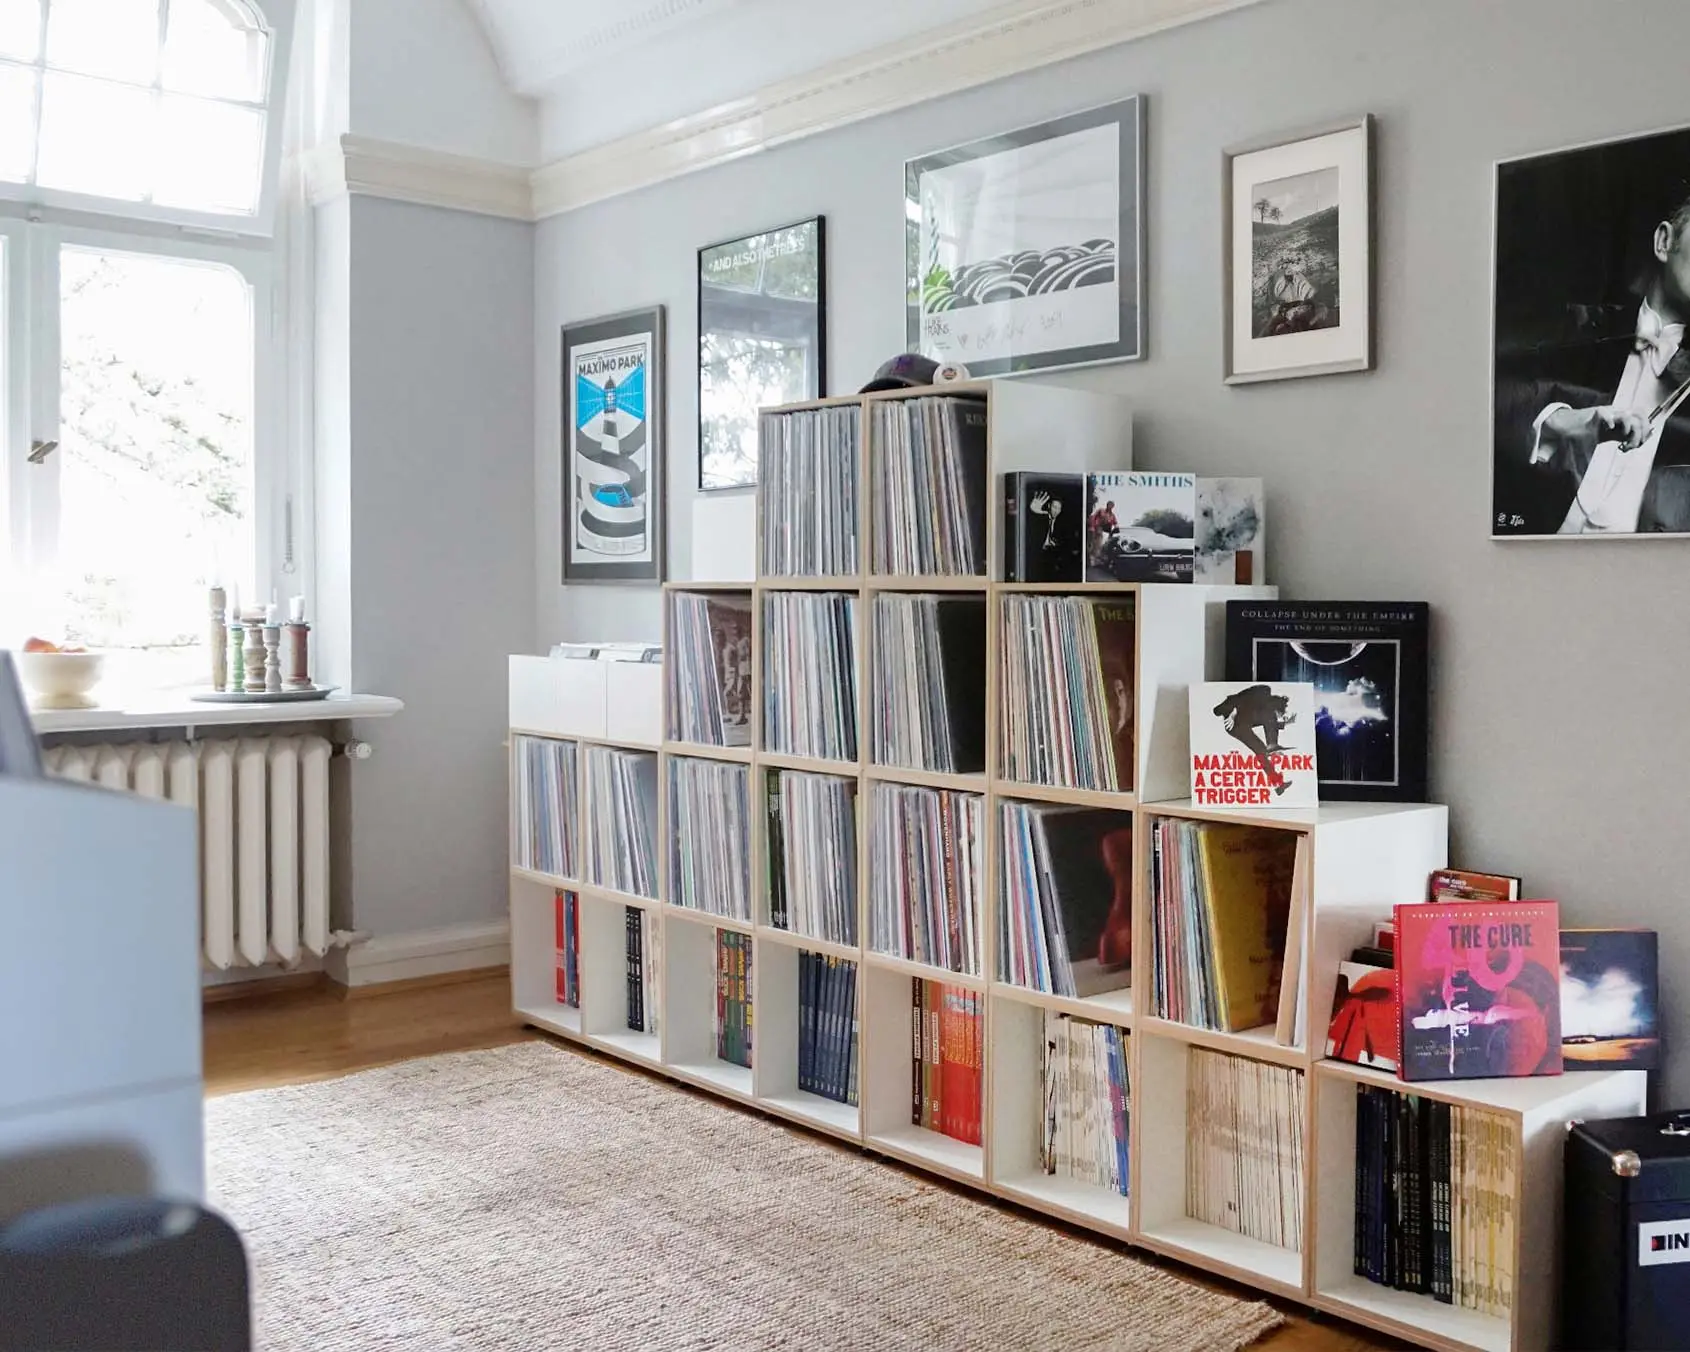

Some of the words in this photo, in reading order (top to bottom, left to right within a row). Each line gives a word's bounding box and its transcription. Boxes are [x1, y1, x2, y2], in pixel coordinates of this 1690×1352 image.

[618, 353, 643, 371] PARK
[1128, 475, 1194, 488] SMITHS
[1241, 610, 1297, 619] COLLAPSE
[1302, 611, 1340, 620] UNDER
[1346, 612, 1369, 620] THE
[1372, 612, 1416, 621] EMPIRE
[1194, 750, 1265, 770] MAXÏMO
[1268, 754, 1314, 770] PARK
[1195, 771, 1206, 787] A
[1195, 788, 1272, 804] TRIGGER
[1448, 924, 1483, 949] THE
[1487, 923, 1534, 949] CURE
